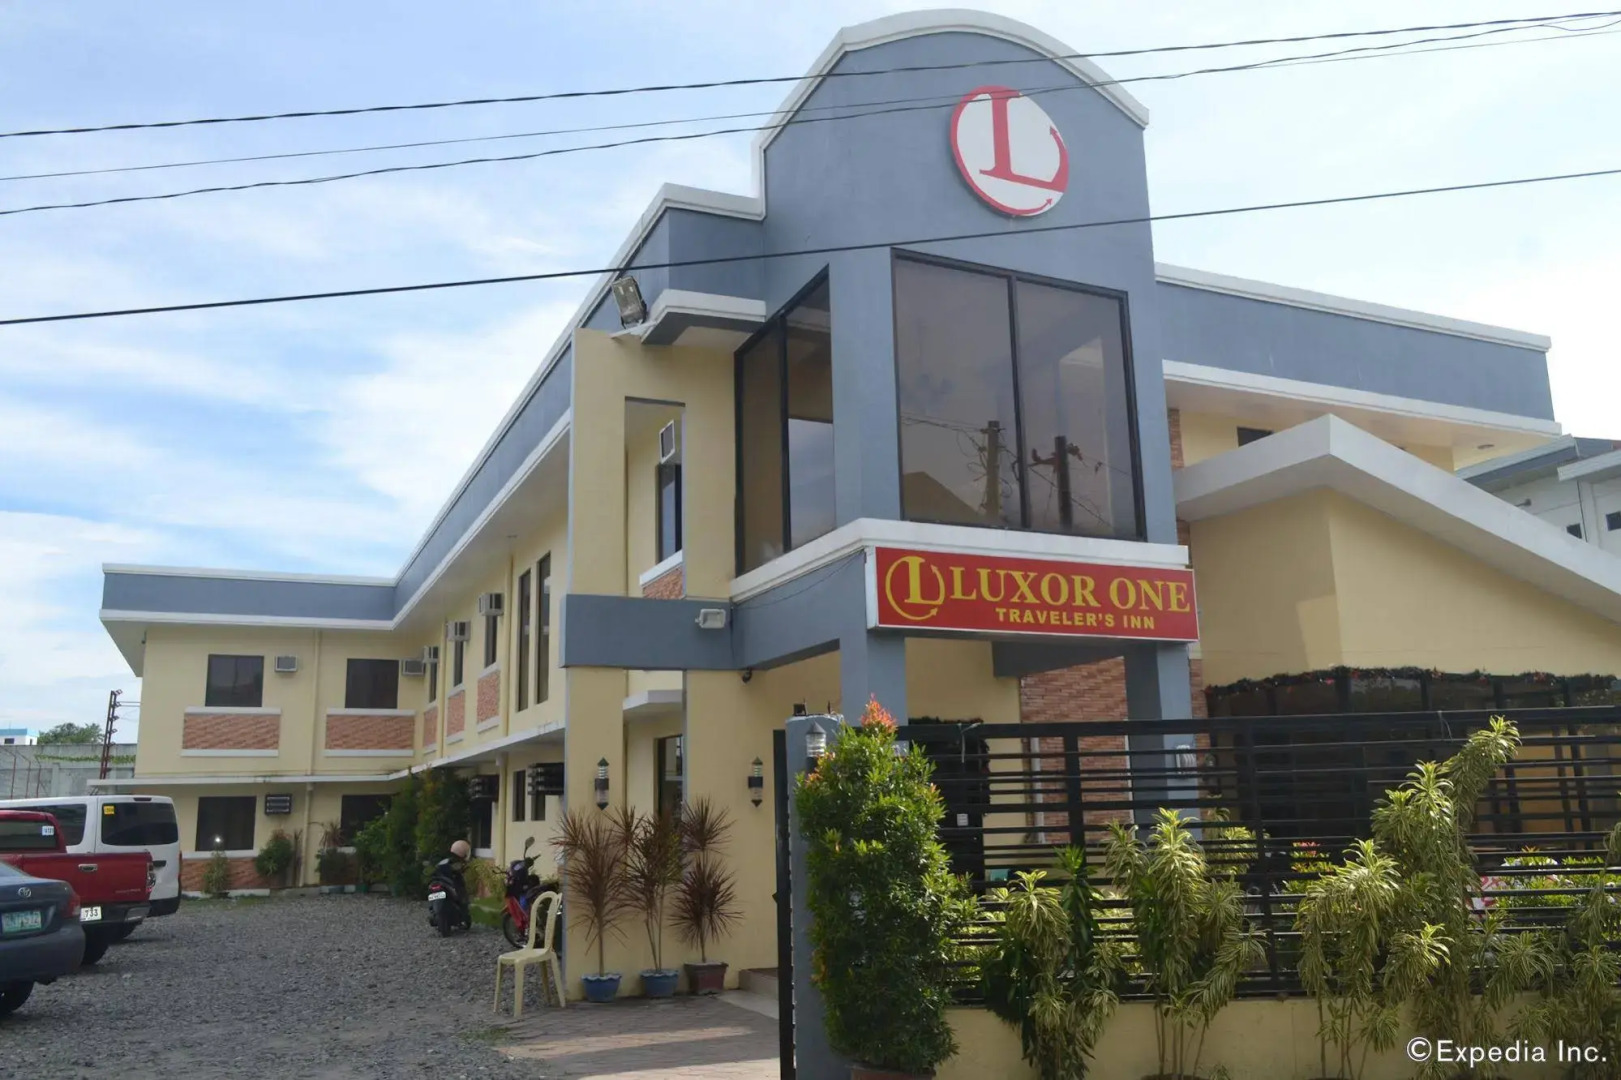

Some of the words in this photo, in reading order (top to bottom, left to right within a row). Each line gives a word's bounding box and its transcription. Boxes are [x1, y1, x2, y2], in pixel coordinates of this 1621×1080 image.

[949, 566, 1101, 607] LUXOR
[1109, 577, 1190, 613] ONE
[995, 607, 1115, 628] TRAVELER'S
[1123, 615, 1155, 629] INN
